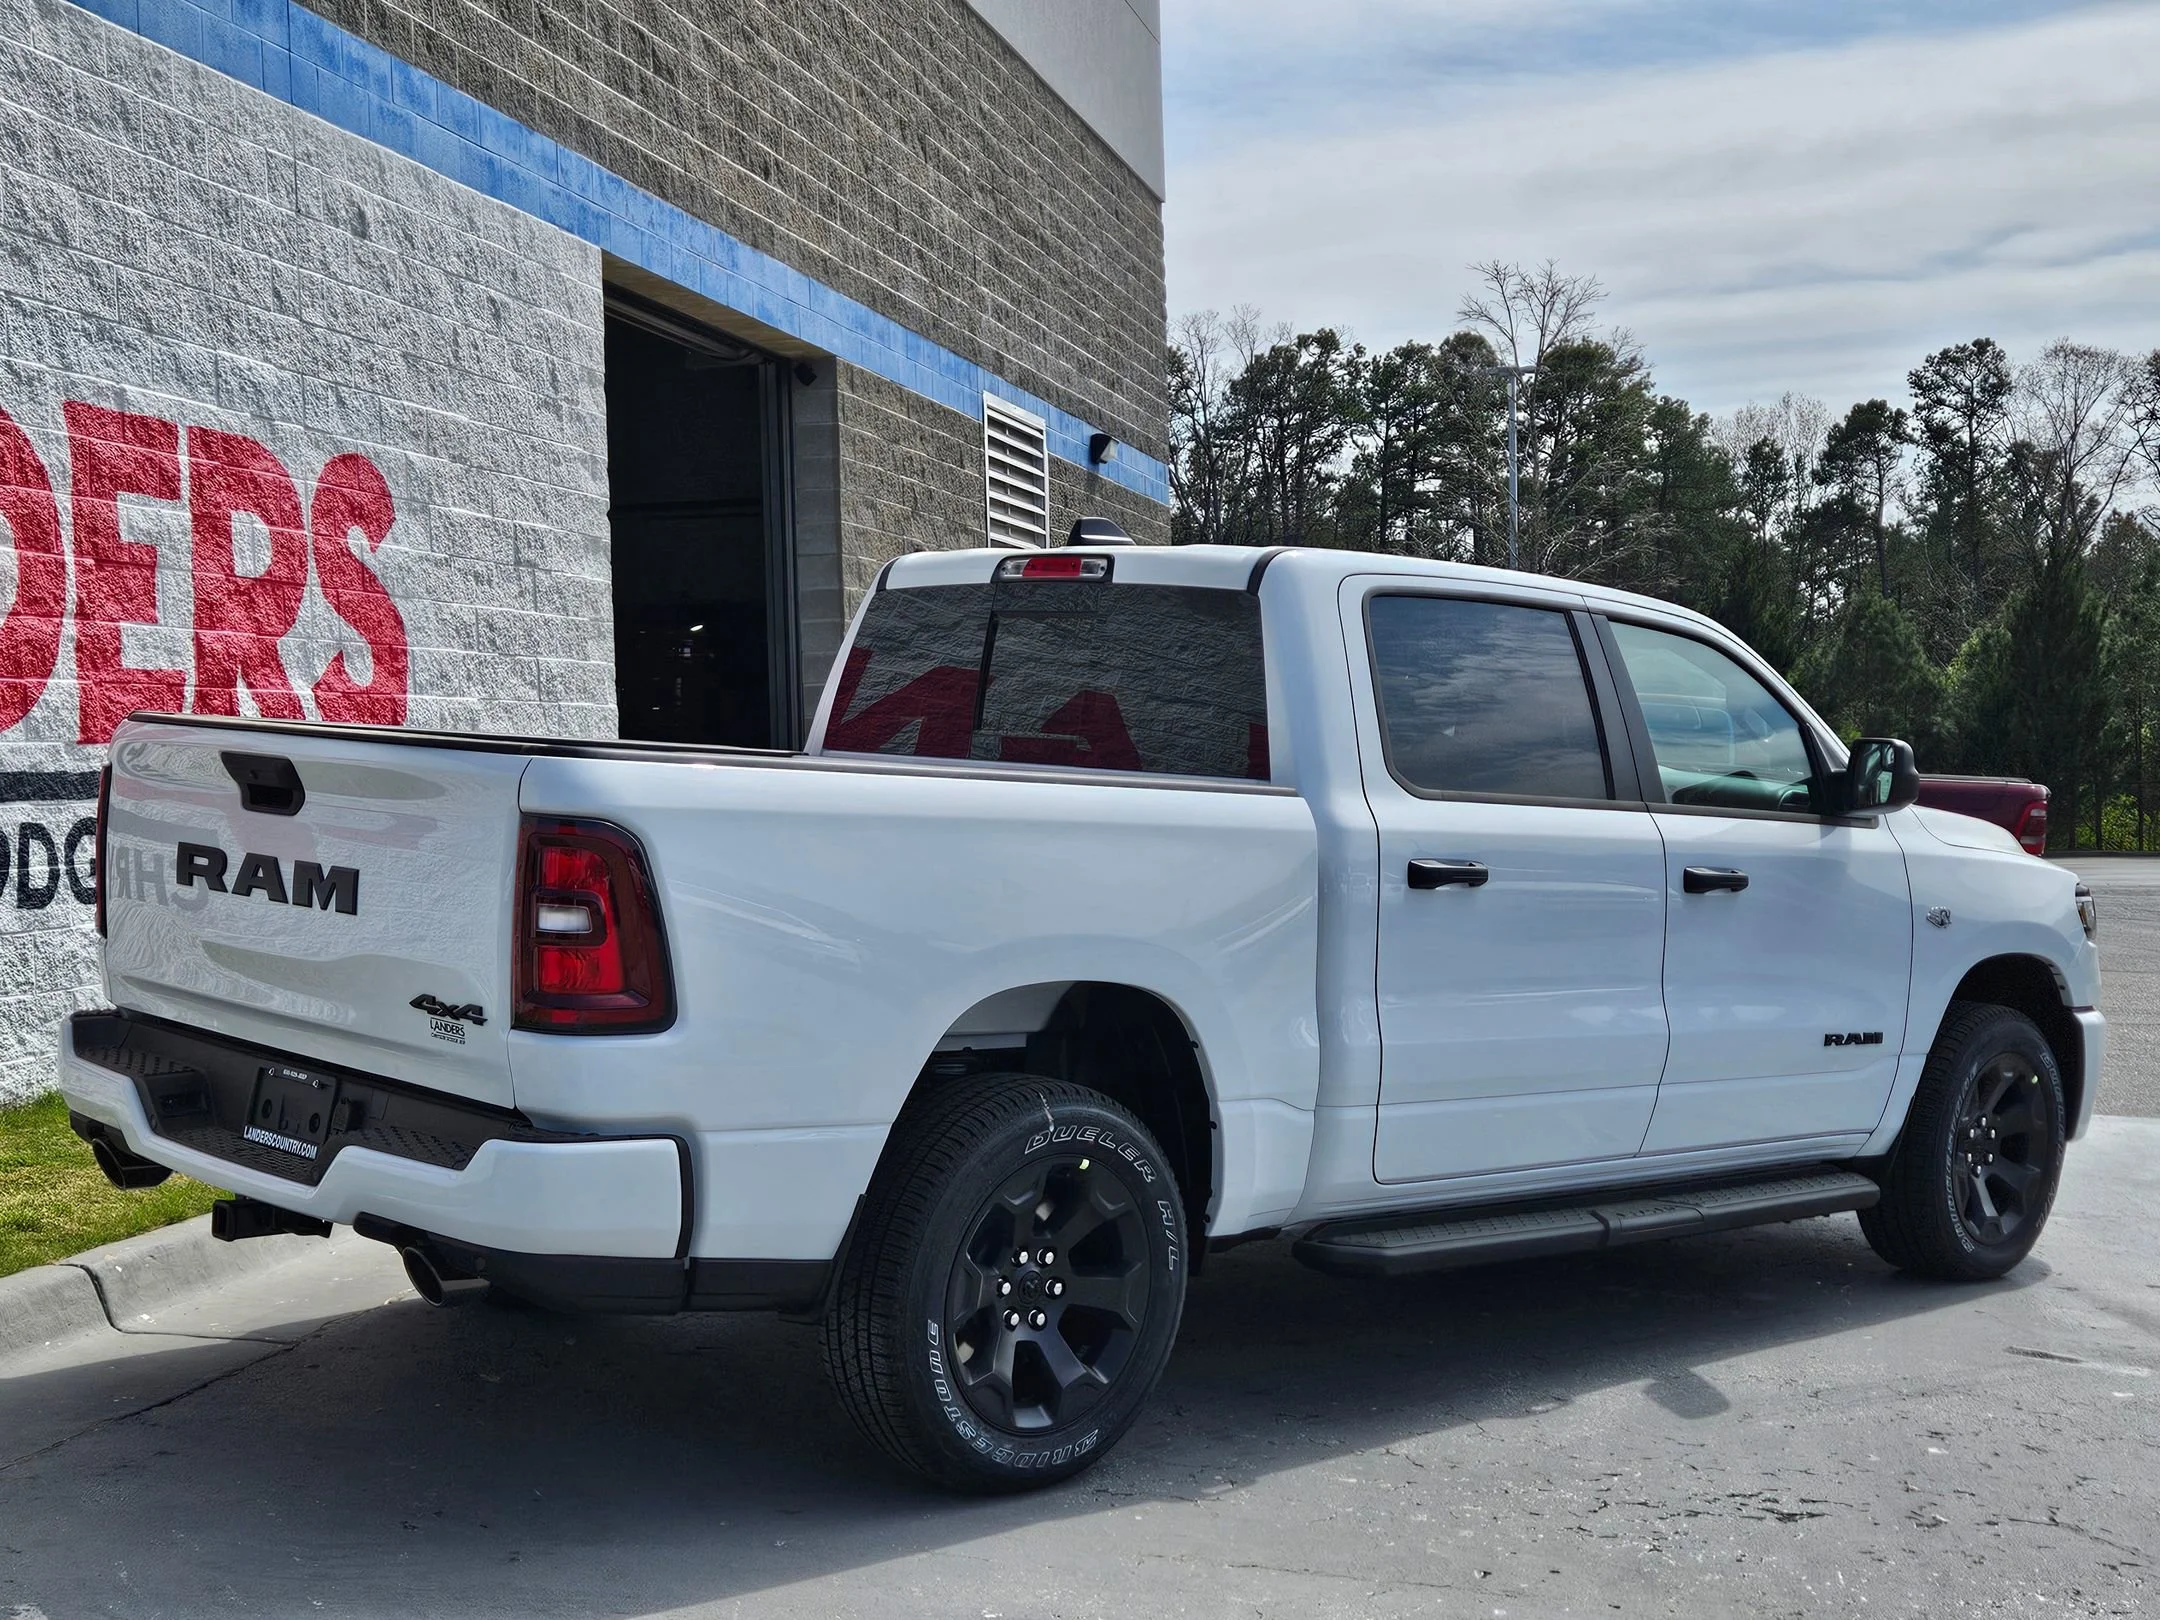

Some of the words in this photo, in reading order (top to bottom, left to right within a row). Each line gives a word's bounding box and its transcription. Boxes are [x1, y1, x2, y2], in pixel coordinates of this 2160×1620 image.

[176, 841, 360, 916] RAM
[430, 1017, 465, 1037] LANDERS
[1823, 1031, 1884, 1047] RAM
[243, 1125, 318, 1160] LANDERSCOUNTRY.COM
[1024, 1125, 1158, 1184] DUELER
[927, 1317, 1099, 1469] BRIDGESTONE
